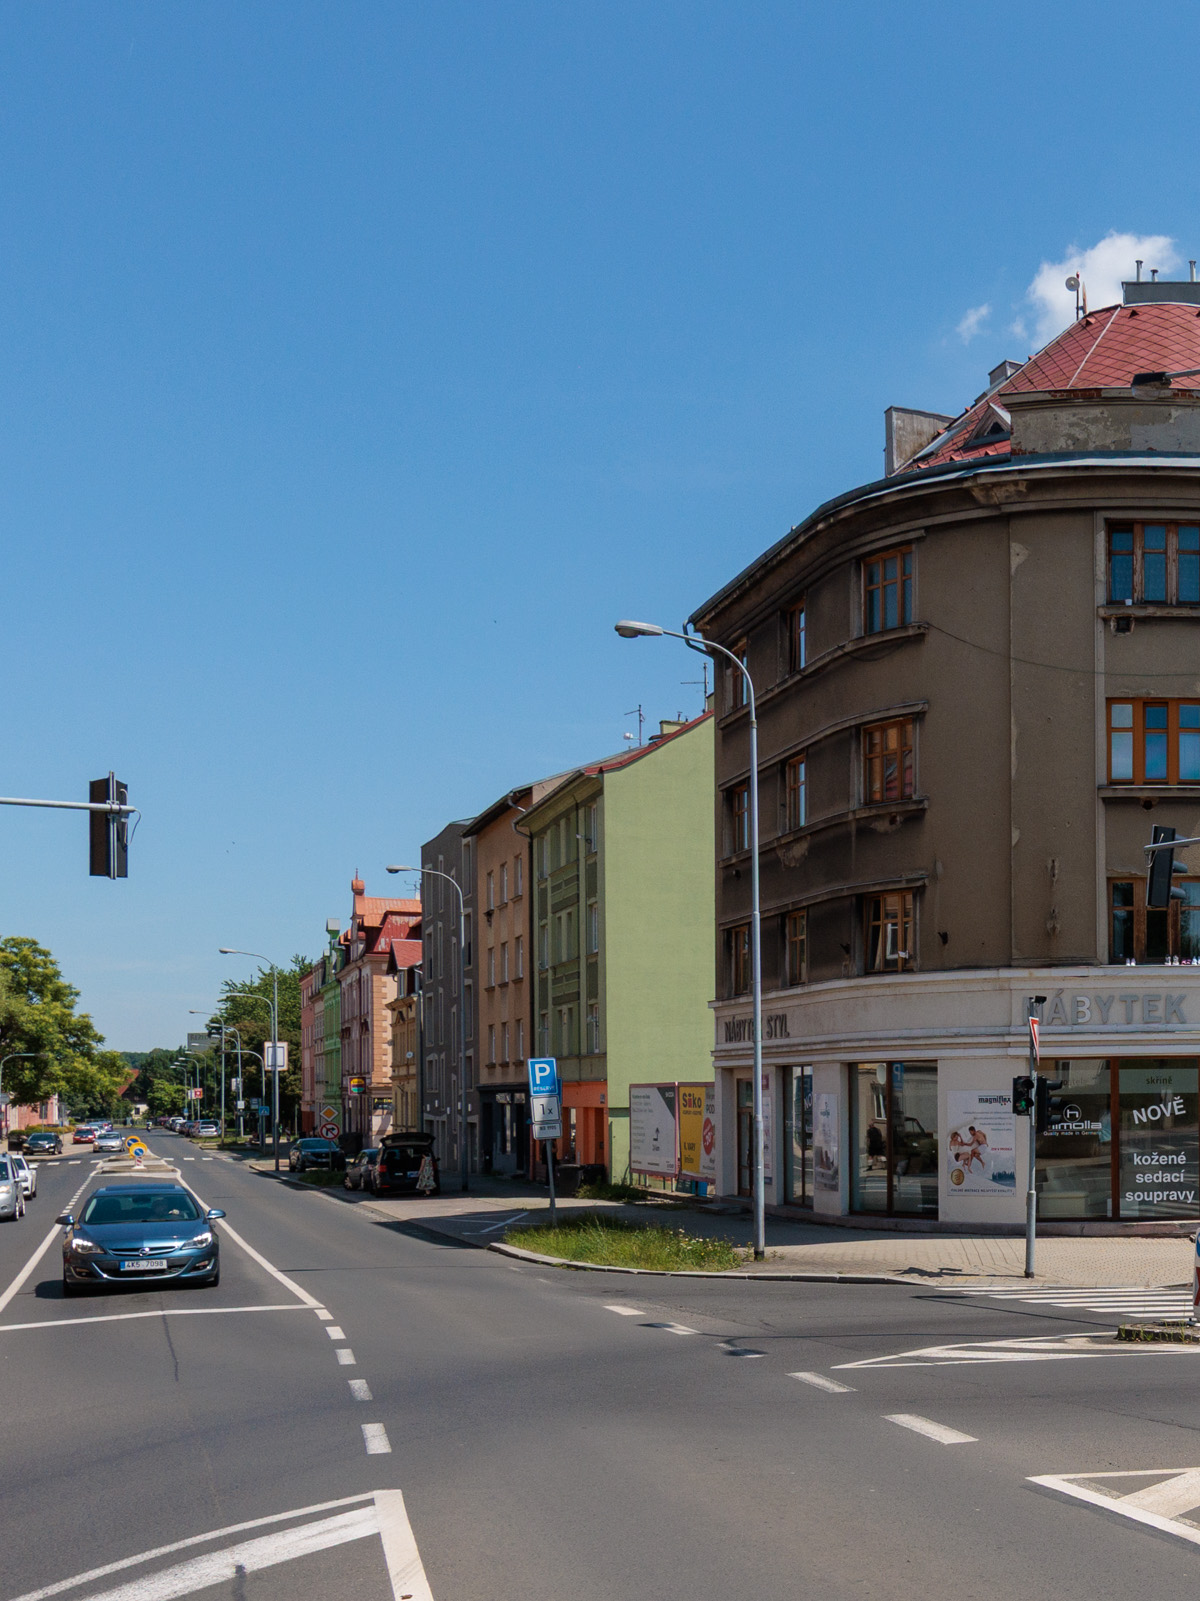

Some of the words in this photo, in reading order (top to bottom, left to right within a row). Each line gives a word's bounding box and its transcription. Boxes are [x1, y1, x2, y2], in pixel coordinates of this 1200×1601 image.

[1023, 989, 1187, 1025] NÁBYTEK
[724, 1015, 762, 1043] NÁBYT
[766, 1013, 790, 1039] STYL
[534, 1063, 551, 1085] P
[1145, 1075, 1173, 1085] skříně
[1132, 1095, 1186, 1125] NOVĚ
[1133, 1151, 1187, 1166] kožené
[1135, 1169, 1185, 1183] sedací
[1125, 1190, 1195, 1204] soupravy
